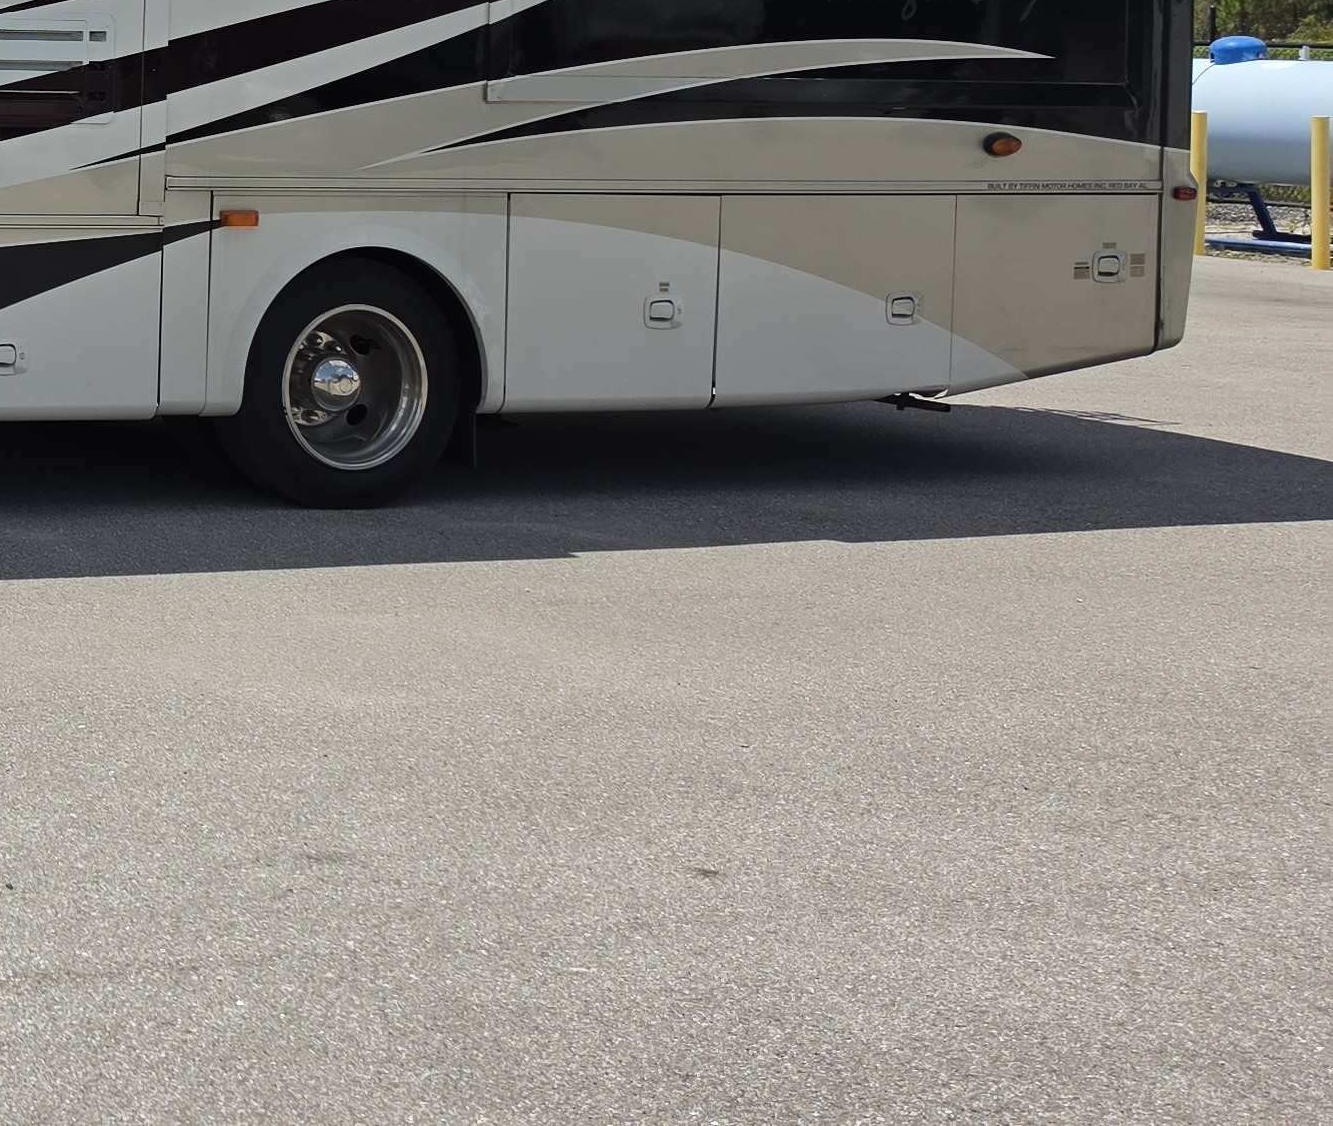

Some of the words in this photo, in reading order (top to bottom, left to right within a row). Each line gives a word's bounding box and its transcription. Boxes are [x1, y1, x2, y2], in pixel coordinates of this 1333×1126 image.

[987, 182, 1007, 190] BUILT
[1008, 182, 1018, 190] BY
[1019, 182, 1041, 190] TIFFIN
[1041, 182, 1067, 190] MOTOR
[1067, 182, 1092, 190] HOMES
[1108, 182, 1123, 190] RED
[1123, 182, 1137, 190] BAY
